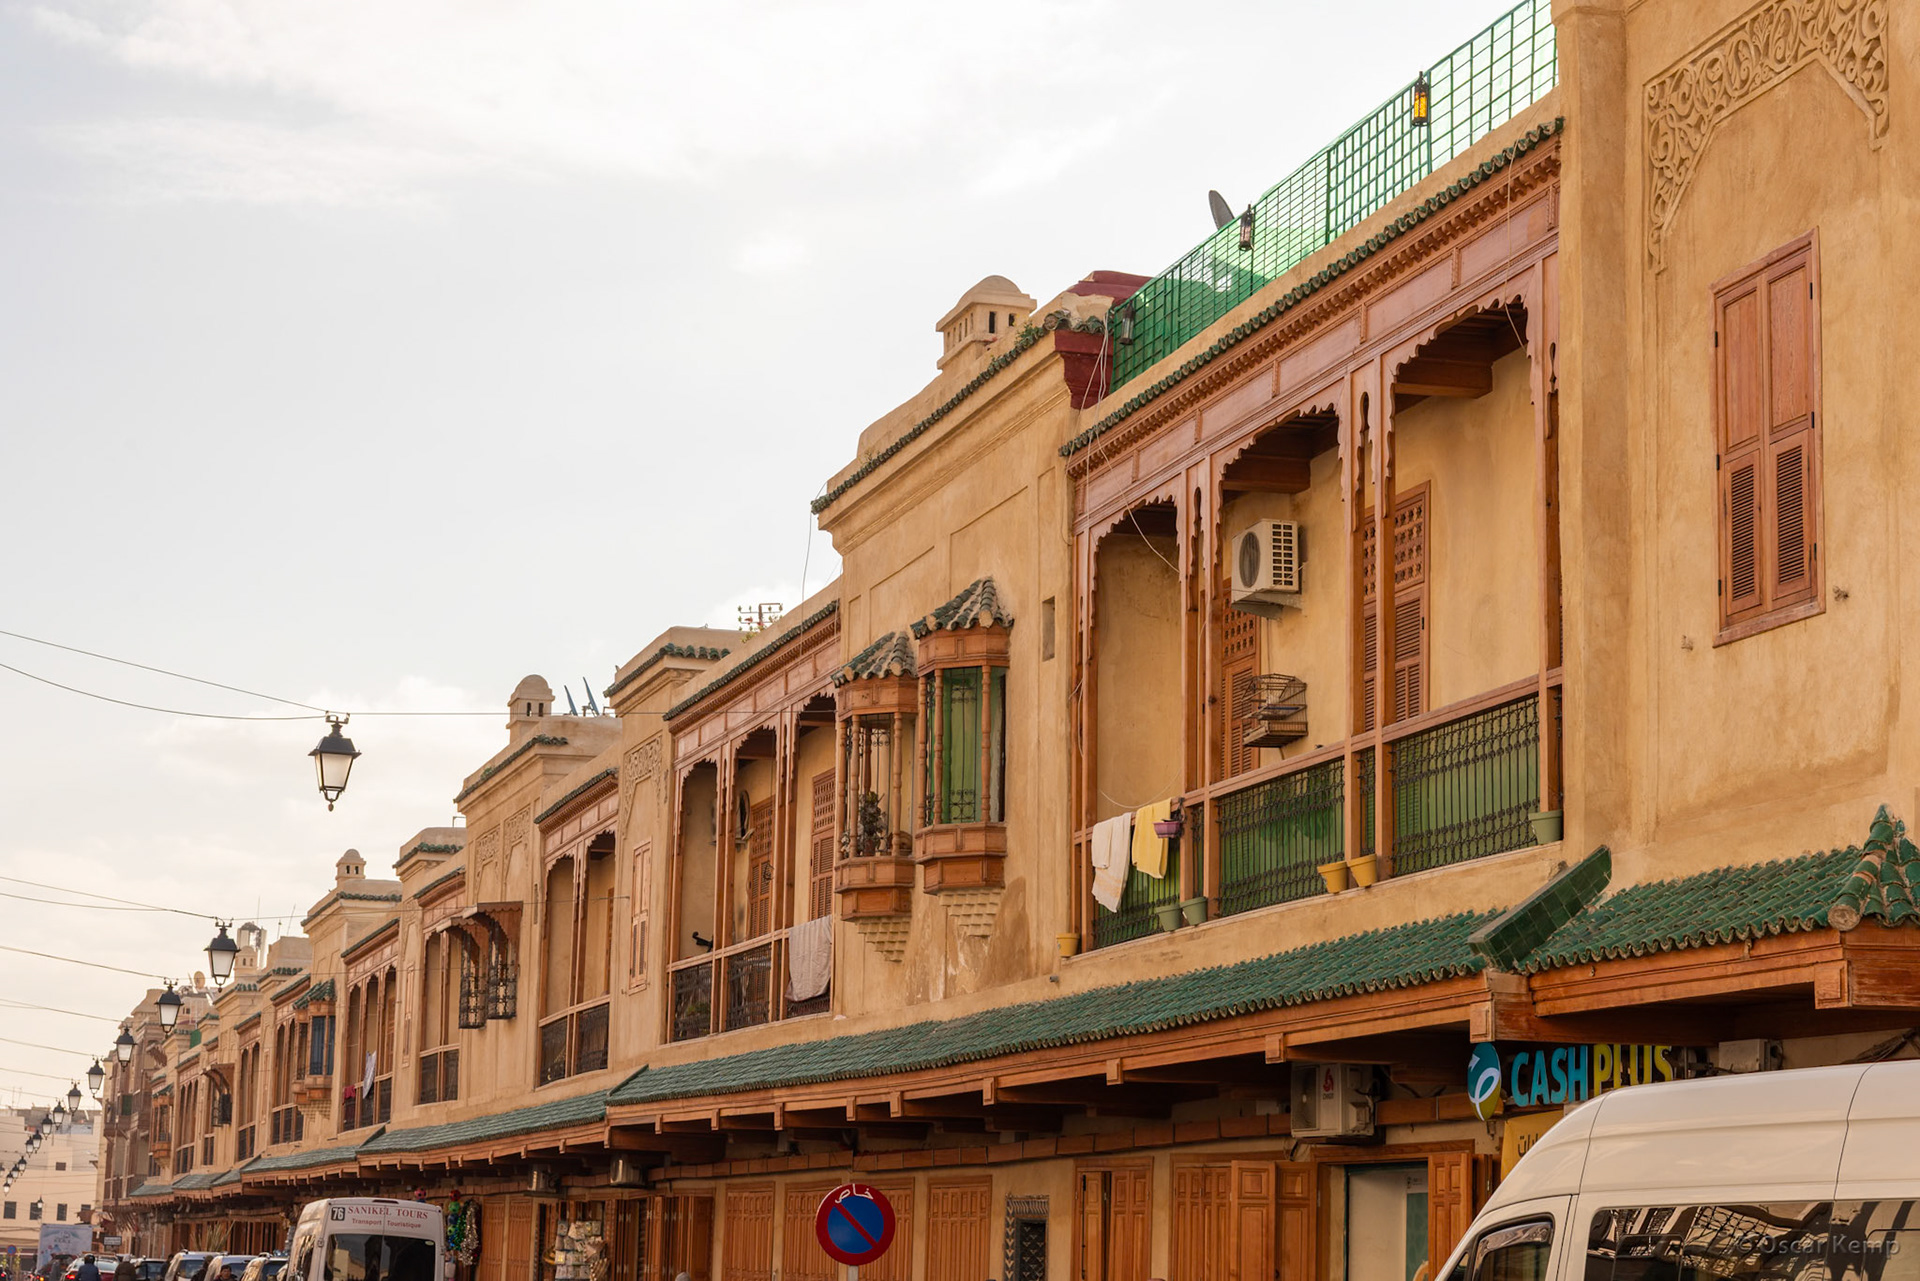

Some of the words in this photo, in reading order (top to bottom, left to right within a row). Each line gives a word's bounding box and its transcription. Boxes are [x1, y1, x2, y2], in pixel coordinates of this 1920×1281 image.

[1511, 1045, 1588, 1107] CASH
[1594, 1043, 1674, 1096] PLUS
[834, 1183, 874, 1204] خاص
[332, 1207, 344, 1220] 76
[396, 1208, 429, 1219] TOURS
[352, 1218, 382, 1226] Transport
[387, 1220, 422, 1229] Touristique
